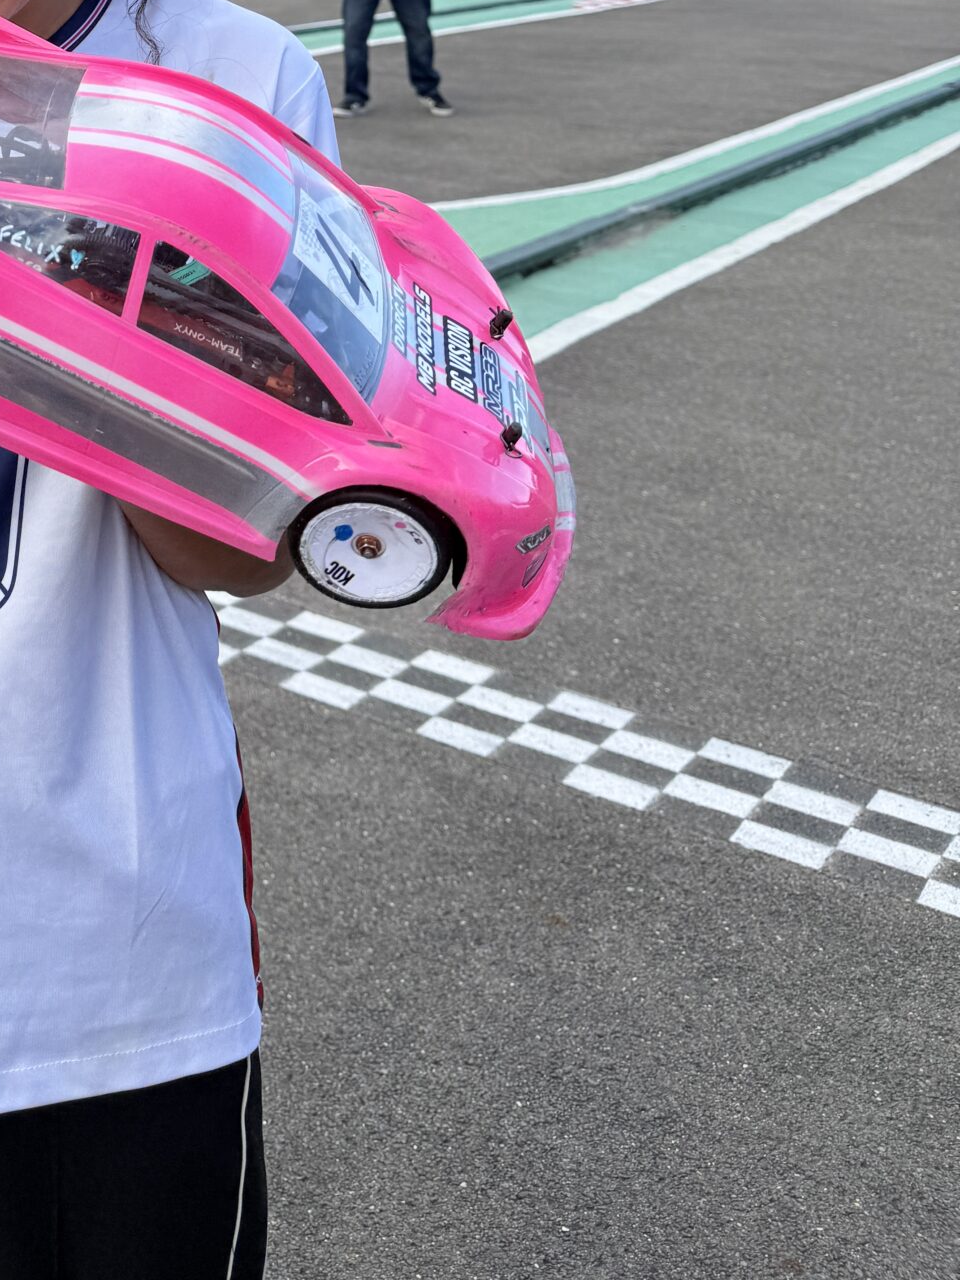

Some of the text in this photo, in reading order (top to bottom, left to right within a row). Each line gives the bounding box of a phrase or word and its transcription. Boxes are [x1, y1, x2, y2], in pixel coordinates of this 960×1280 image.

[315, 212, 375, 306] 4
[414, 285, 435, 392] MB MODELS
[447, 320, 474, 400] RC VISION
[482, 344, 503, 419] MR33
[324, 561, 355, 586] KOC
